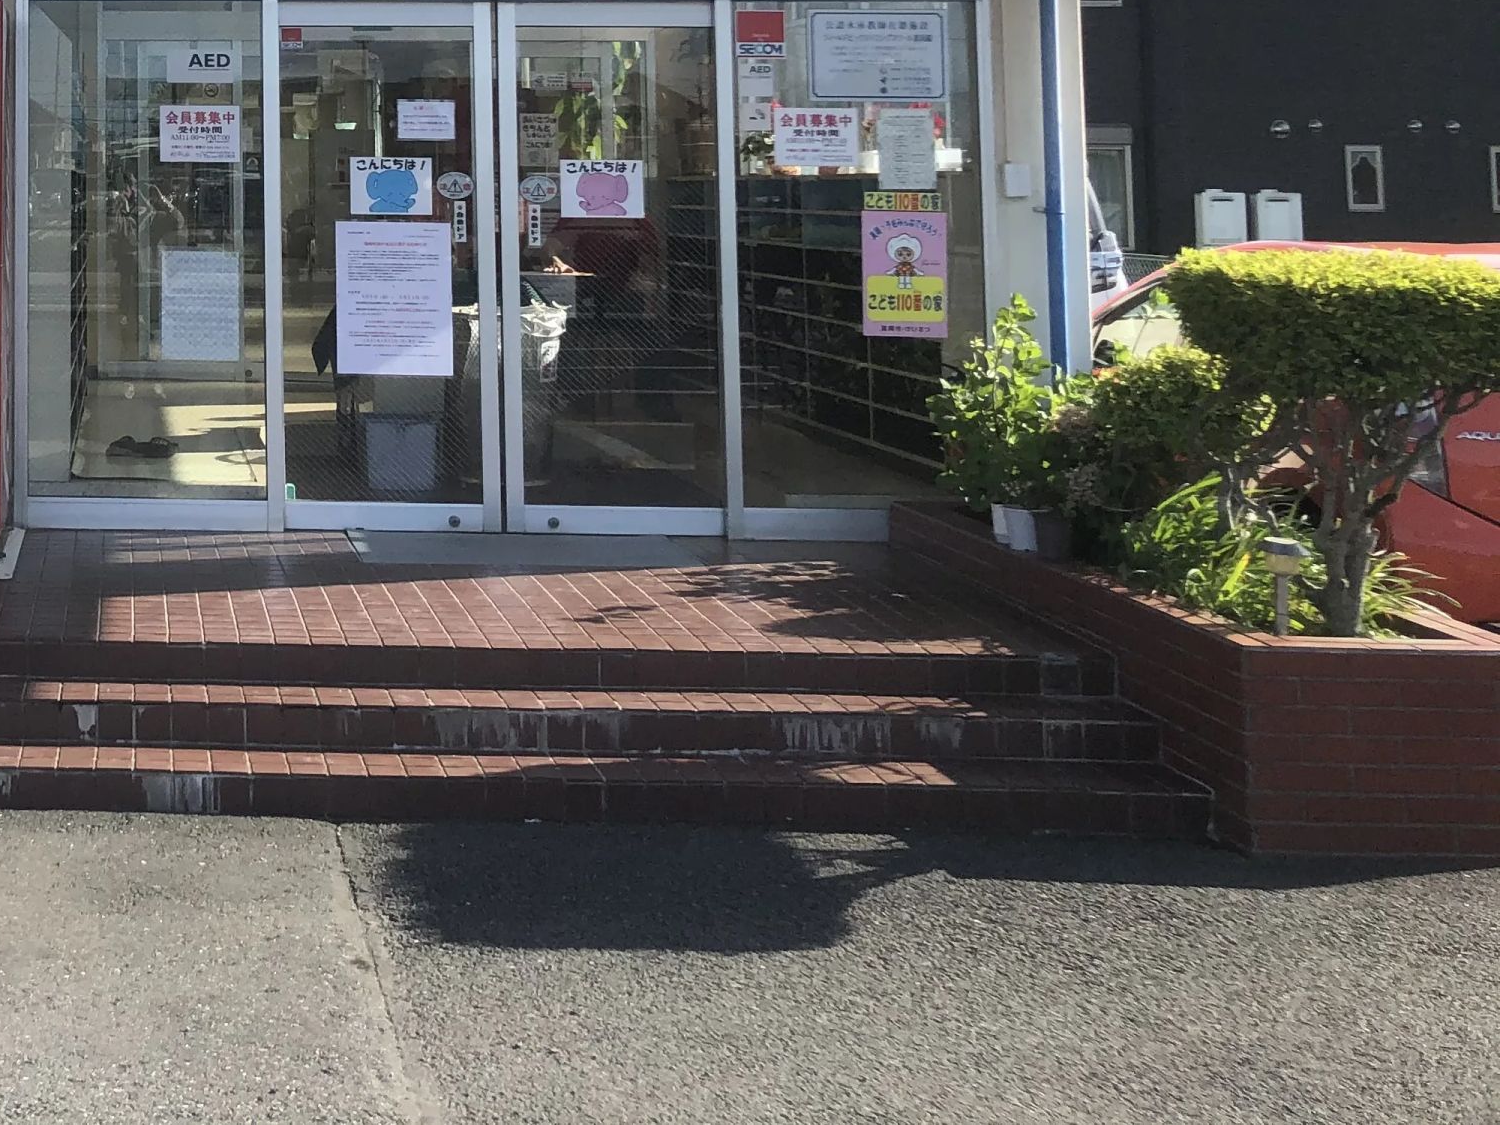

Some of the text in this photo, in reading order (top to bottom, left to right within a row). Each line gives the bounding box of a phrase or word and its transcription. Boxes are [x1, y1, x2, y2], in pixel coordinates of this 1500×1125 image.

[739, 43, 783, 55] SECOM
[188, 53, 231, 68] AED
[749, 65, 771, 74] AED
[165, 110, 236, 125] 会員募集中
[780, 113, 852, 128] 会員募集中
[177, 126, 223, 134] 受付時間
[865, 193, 941, 210] こども110番の家
[868, 293, 943, 312] こども110番の家
